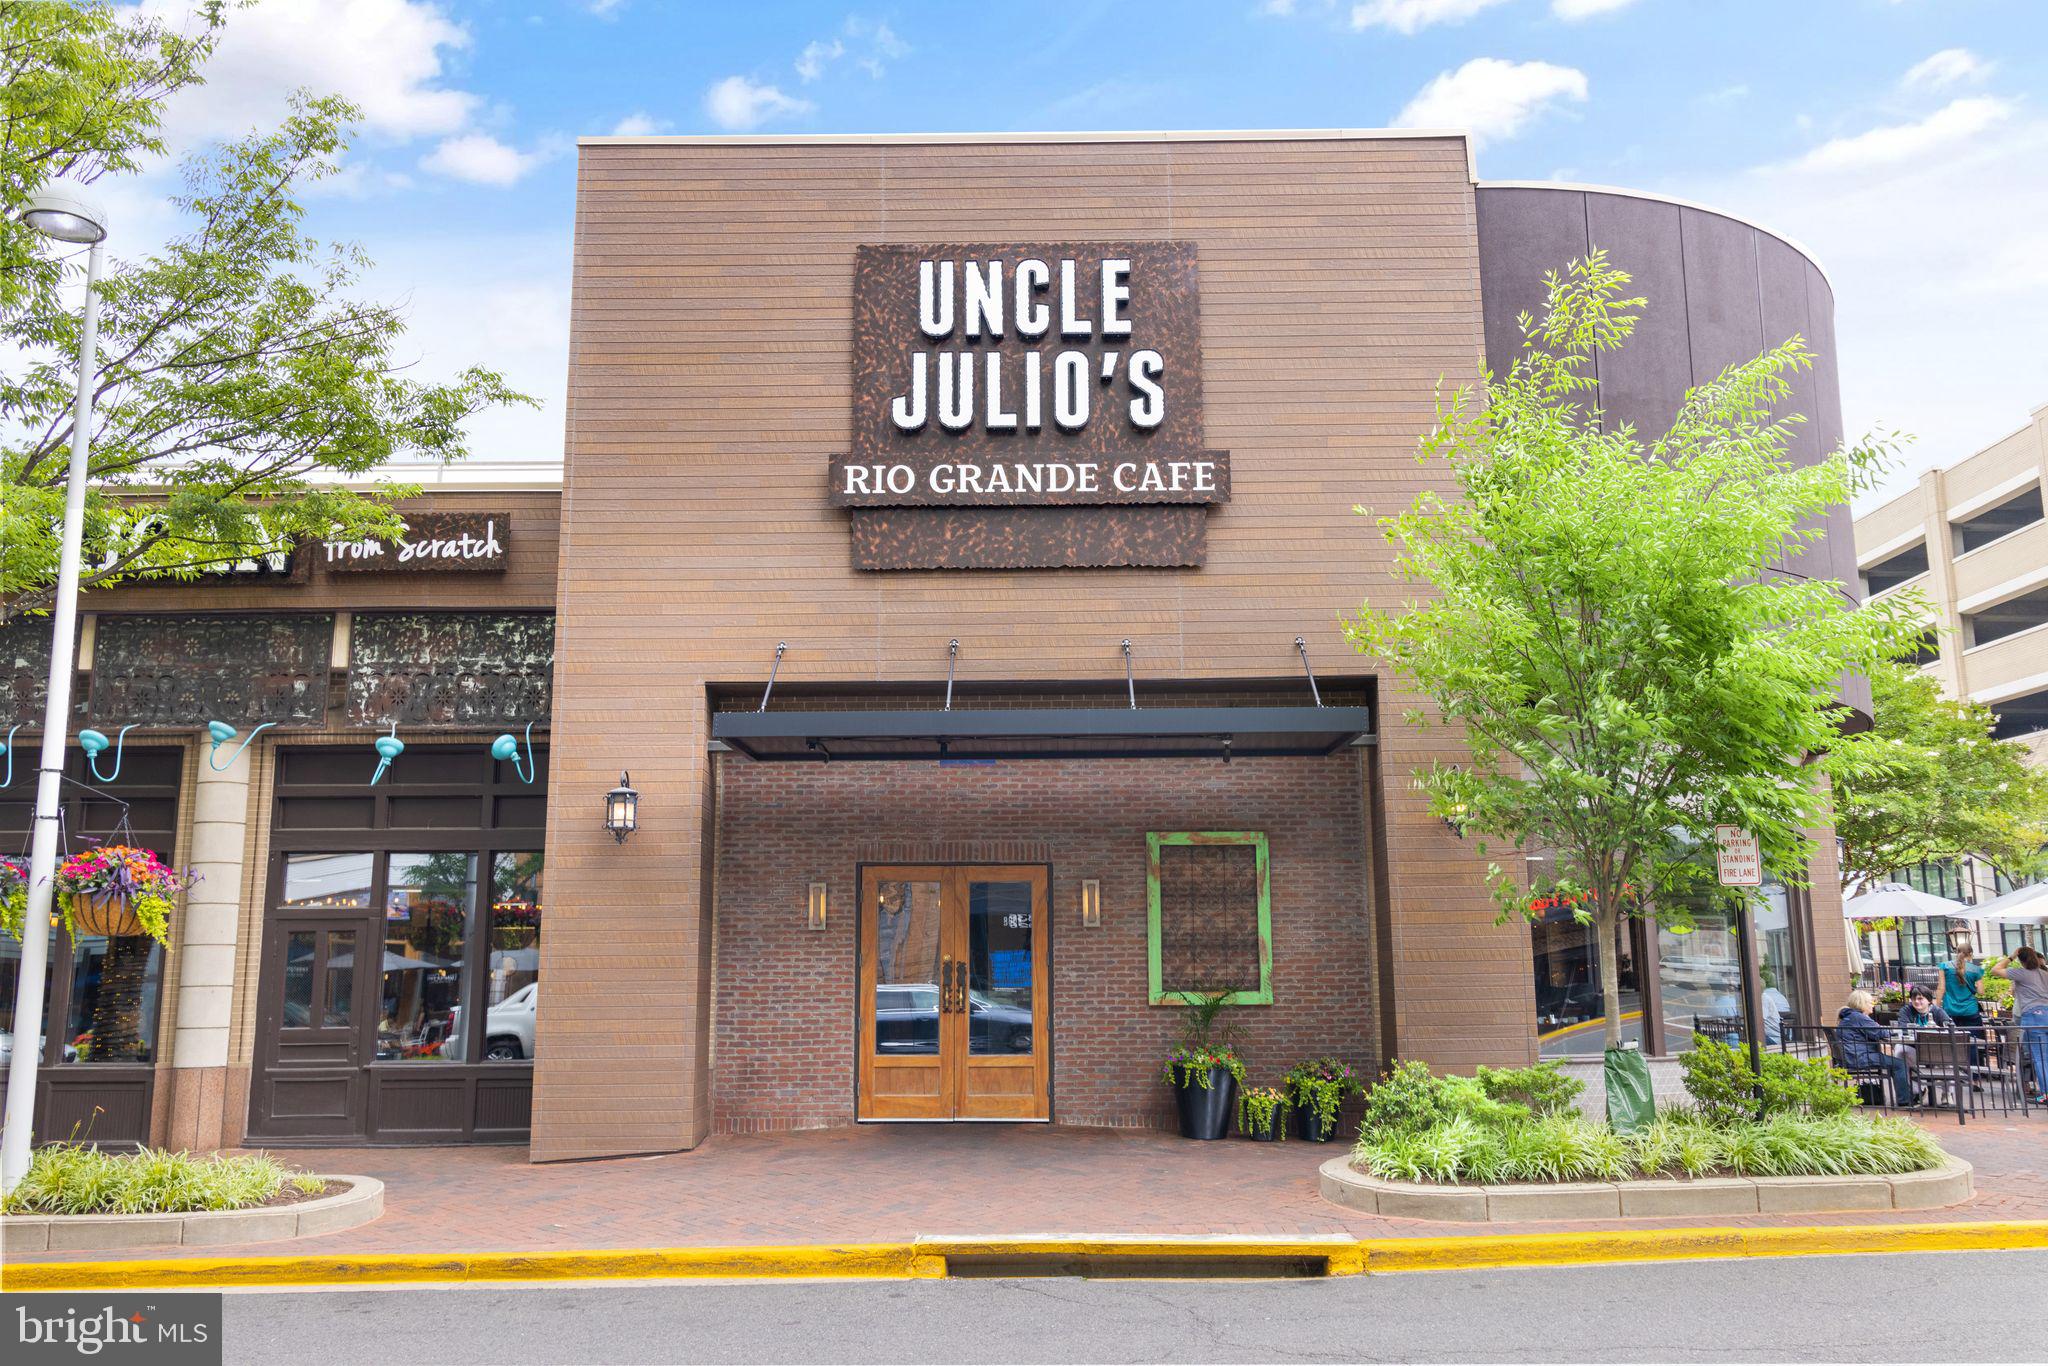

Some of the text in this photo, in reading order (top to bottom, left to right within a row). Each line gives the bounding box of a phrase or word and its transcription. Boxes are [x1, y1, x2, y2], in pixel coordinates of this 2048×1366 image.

[918, 257, 1133, 340] UNCLE
[891, 349, 1166, 433] JULIO'S
[843, 461, 1217, 495] RIO GRANDE CAFE
[1730, 830, 1742, 838] NO
[1722, 838, 1752, 847] PARKING
[1722, 854, 1755, 863] STANDING
[1723, 868, 1756, 877] FIRE LANE
